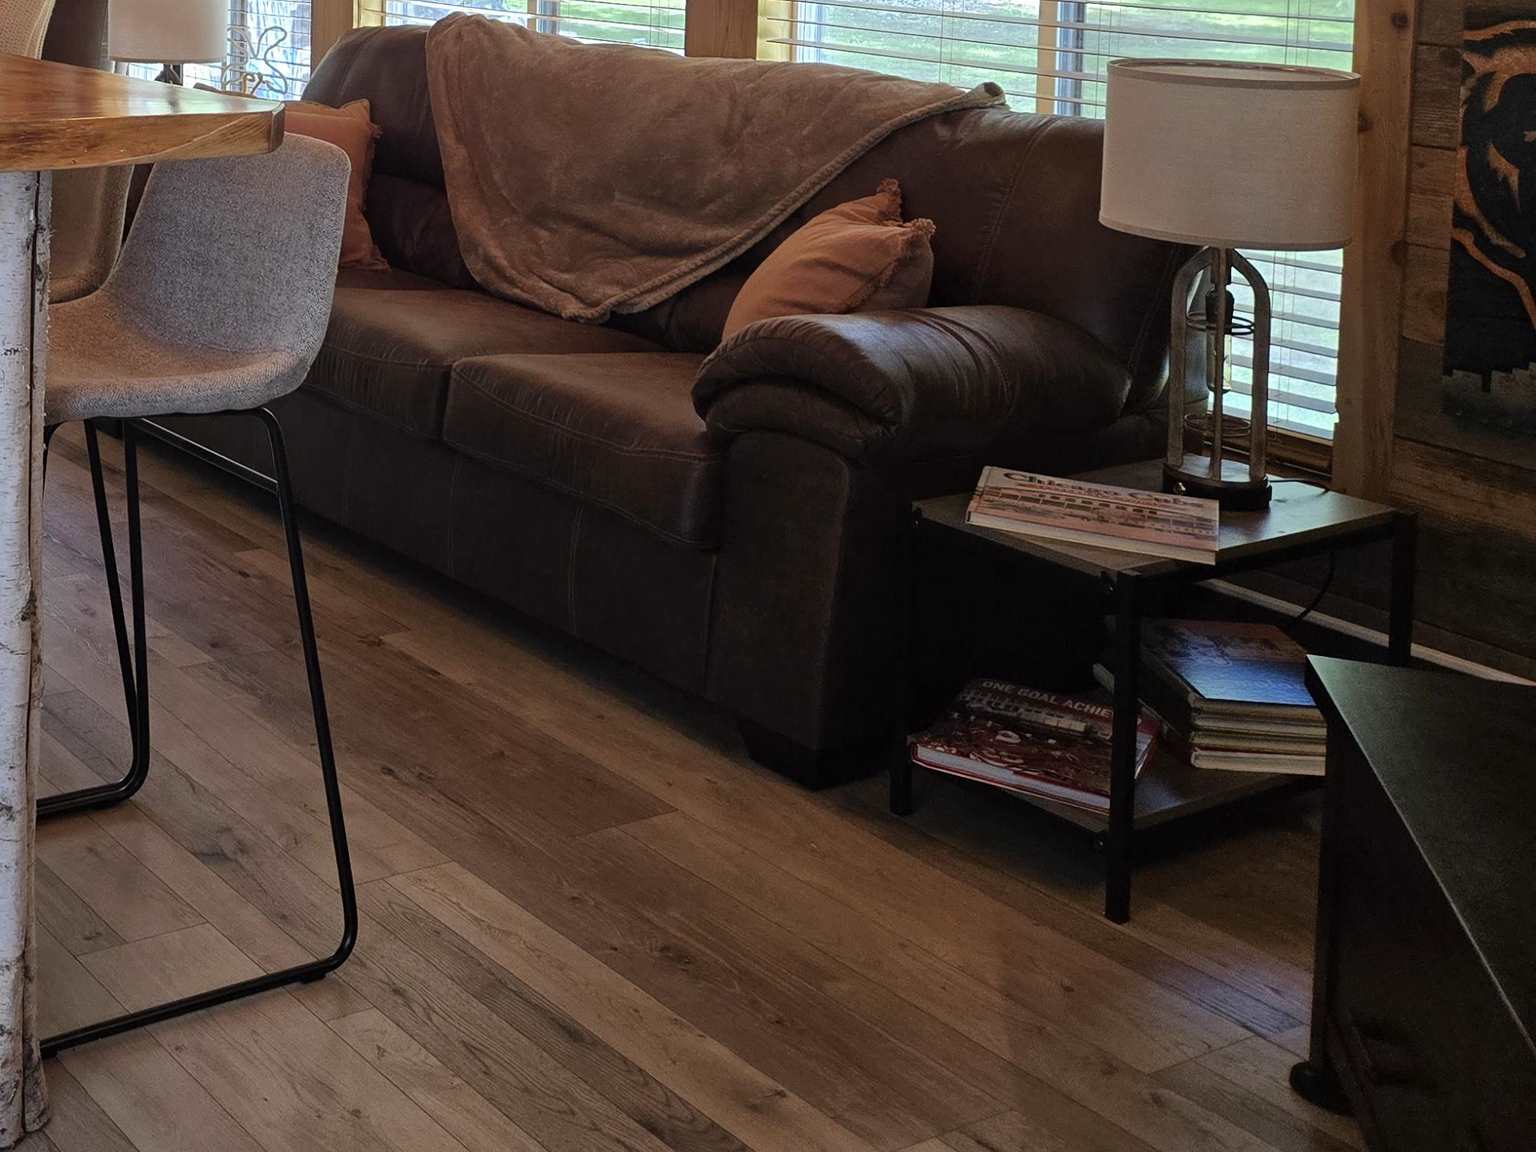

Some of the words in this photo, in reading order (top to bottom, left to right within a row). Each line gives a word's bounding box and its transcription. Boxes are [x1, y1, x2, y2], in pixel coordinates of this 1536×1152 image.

[981, 681, 1016, 693] ONE
[1016, 688, 1057, 705] GOAL
[1063, 699, 1113, 720] ACHIE
